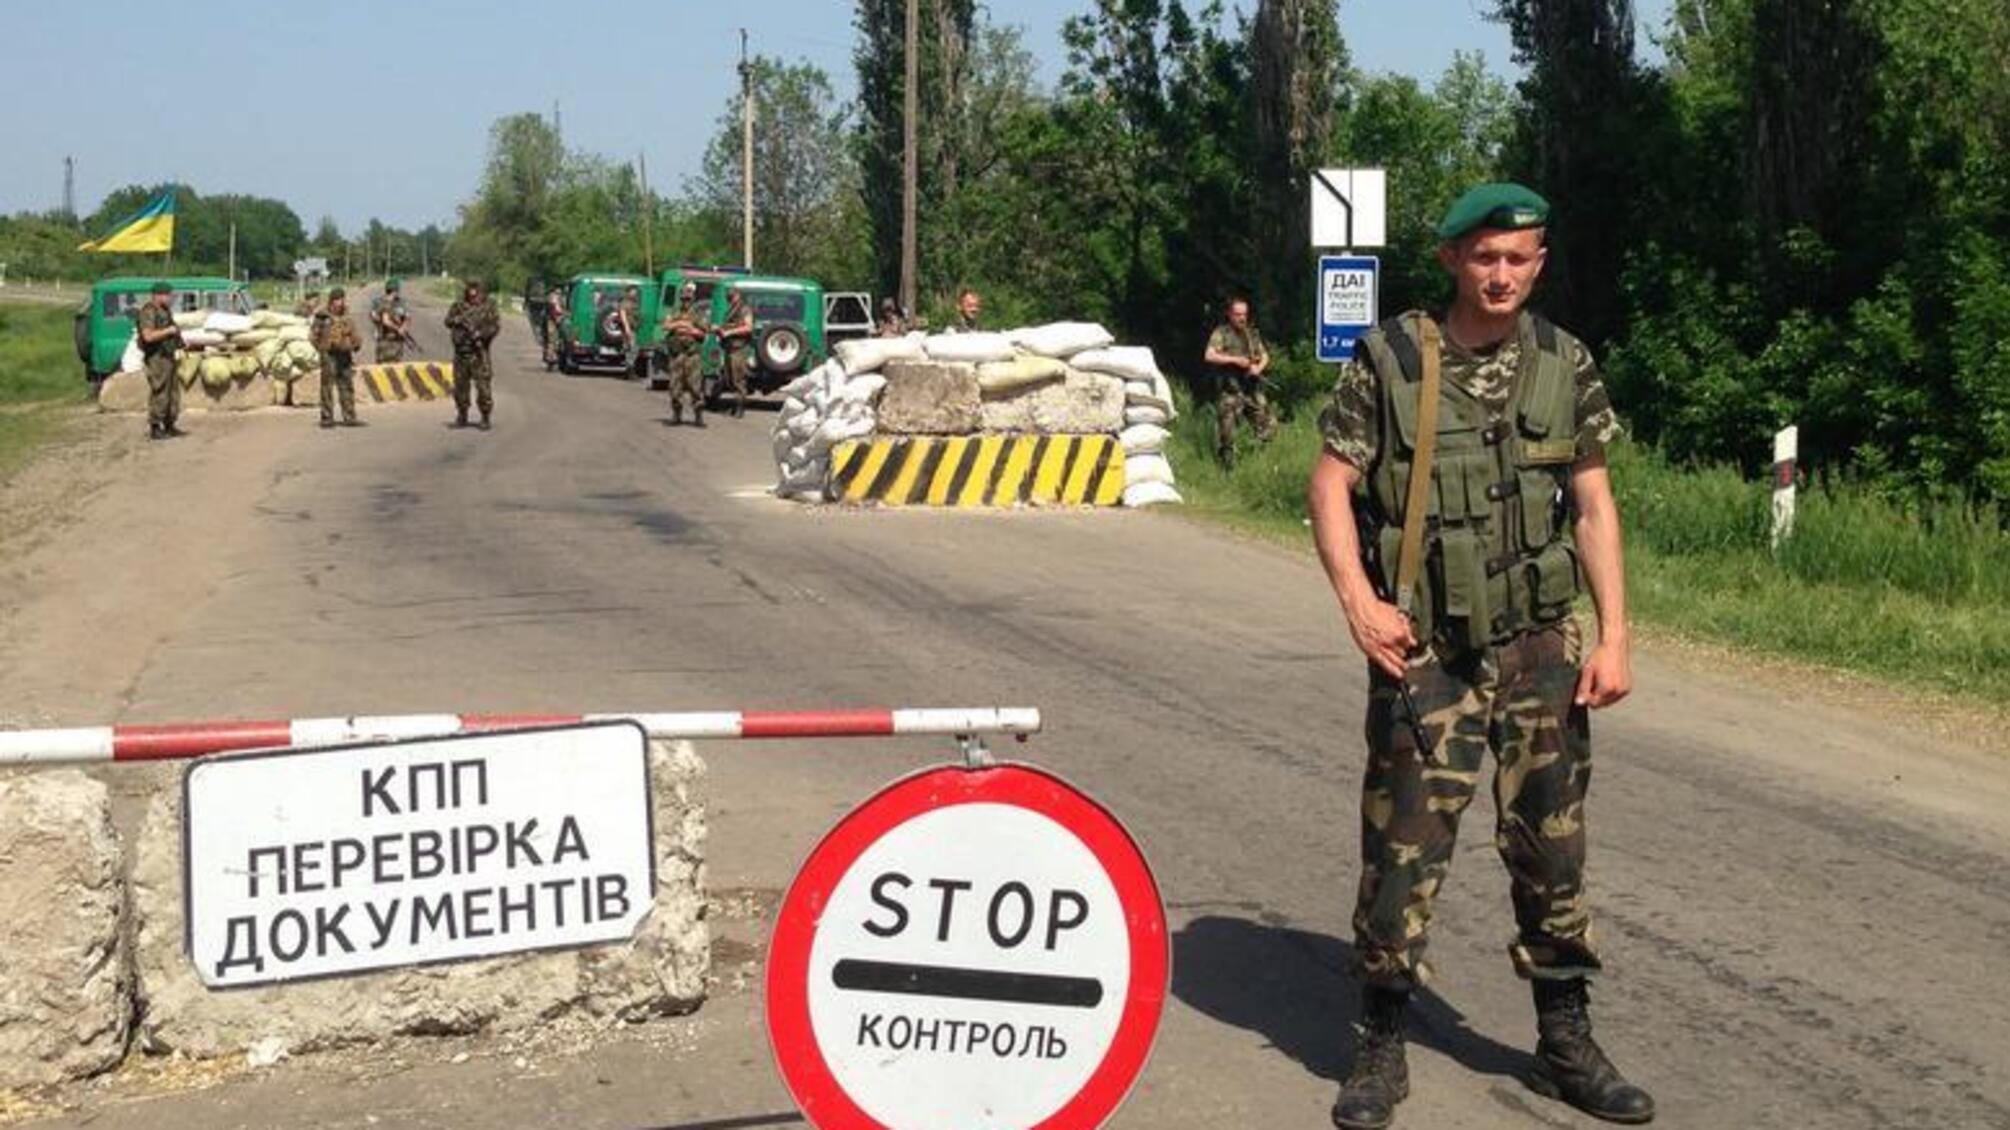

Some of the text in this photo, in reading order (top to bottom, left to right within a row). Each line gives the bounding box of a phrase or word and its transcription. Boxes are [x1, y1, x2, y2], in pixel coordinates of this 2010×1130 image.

[1328, 291, 1367, 300] TRAFFIC
[1330, 302, 1366, 310] POLICE
[1331, 273, 1365, 289] ДАІ
[361, 759, 489, 817] КПП
[248, 815, 590, 898] ПЕРЕВІРКА
[215, 873, 632, 978] ДОКУМЕНТІВ
[861, 872, 1089, 950] STOP
[857, 1013, 1068, 1060] КОНТРОЛЬ
